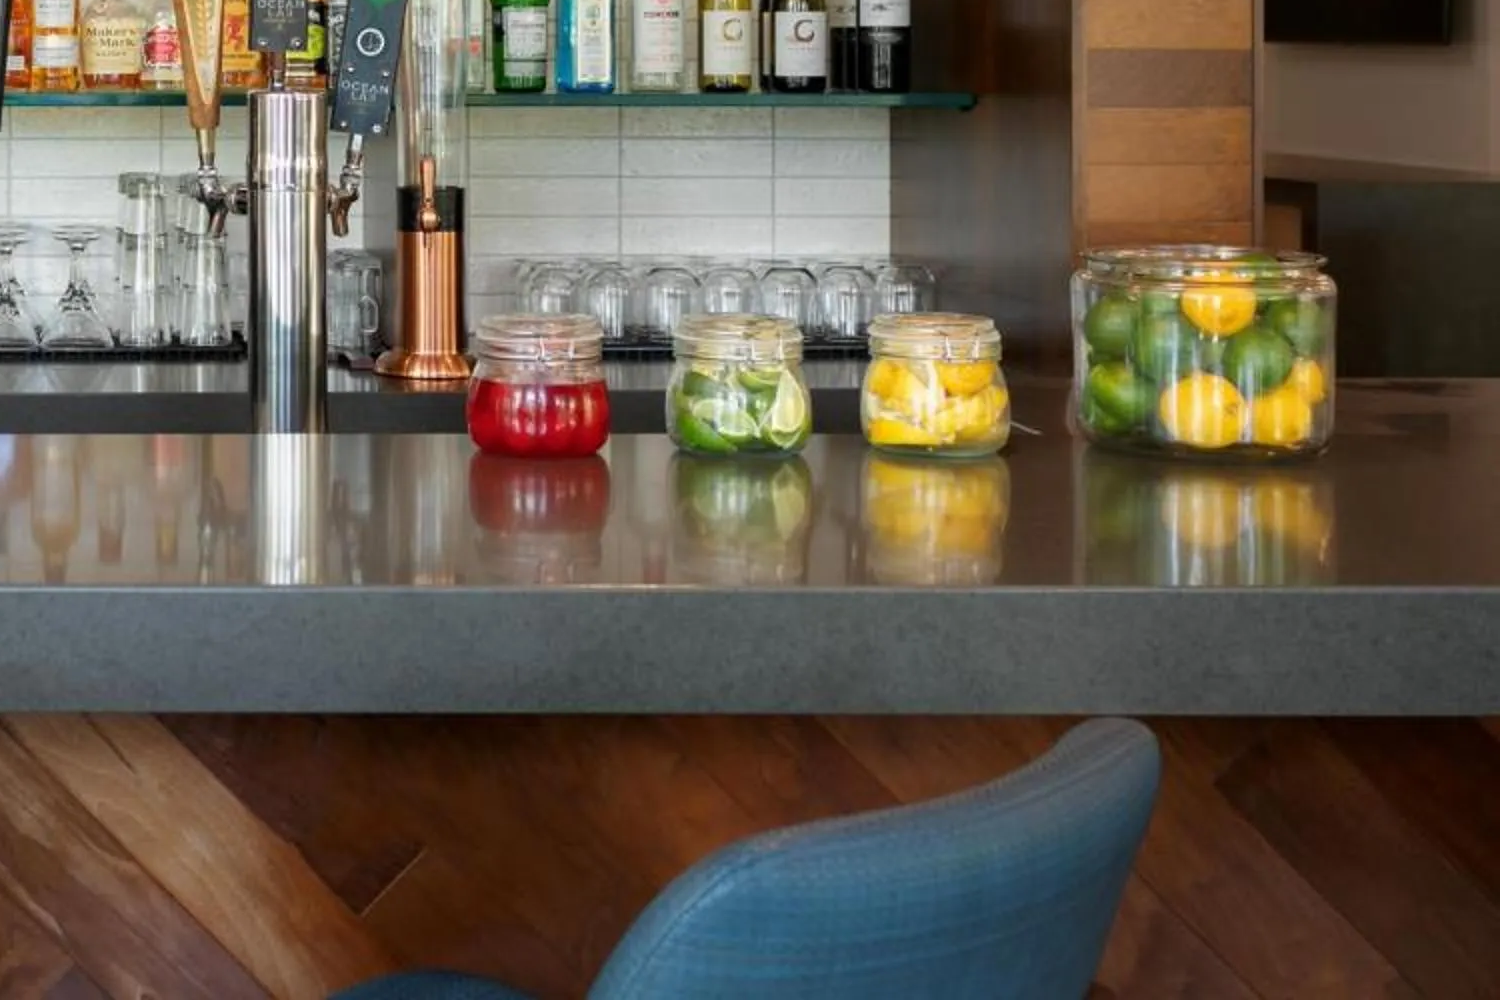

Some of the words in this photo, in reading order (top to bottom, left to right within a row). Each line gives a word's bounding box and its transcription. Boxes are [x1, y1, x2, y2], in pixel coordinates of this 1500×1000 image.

[258, 0, 305, 9] OCEAN
[100, 37, 135, 48] Mark
[341, 80, 389, 95] OCEAN
